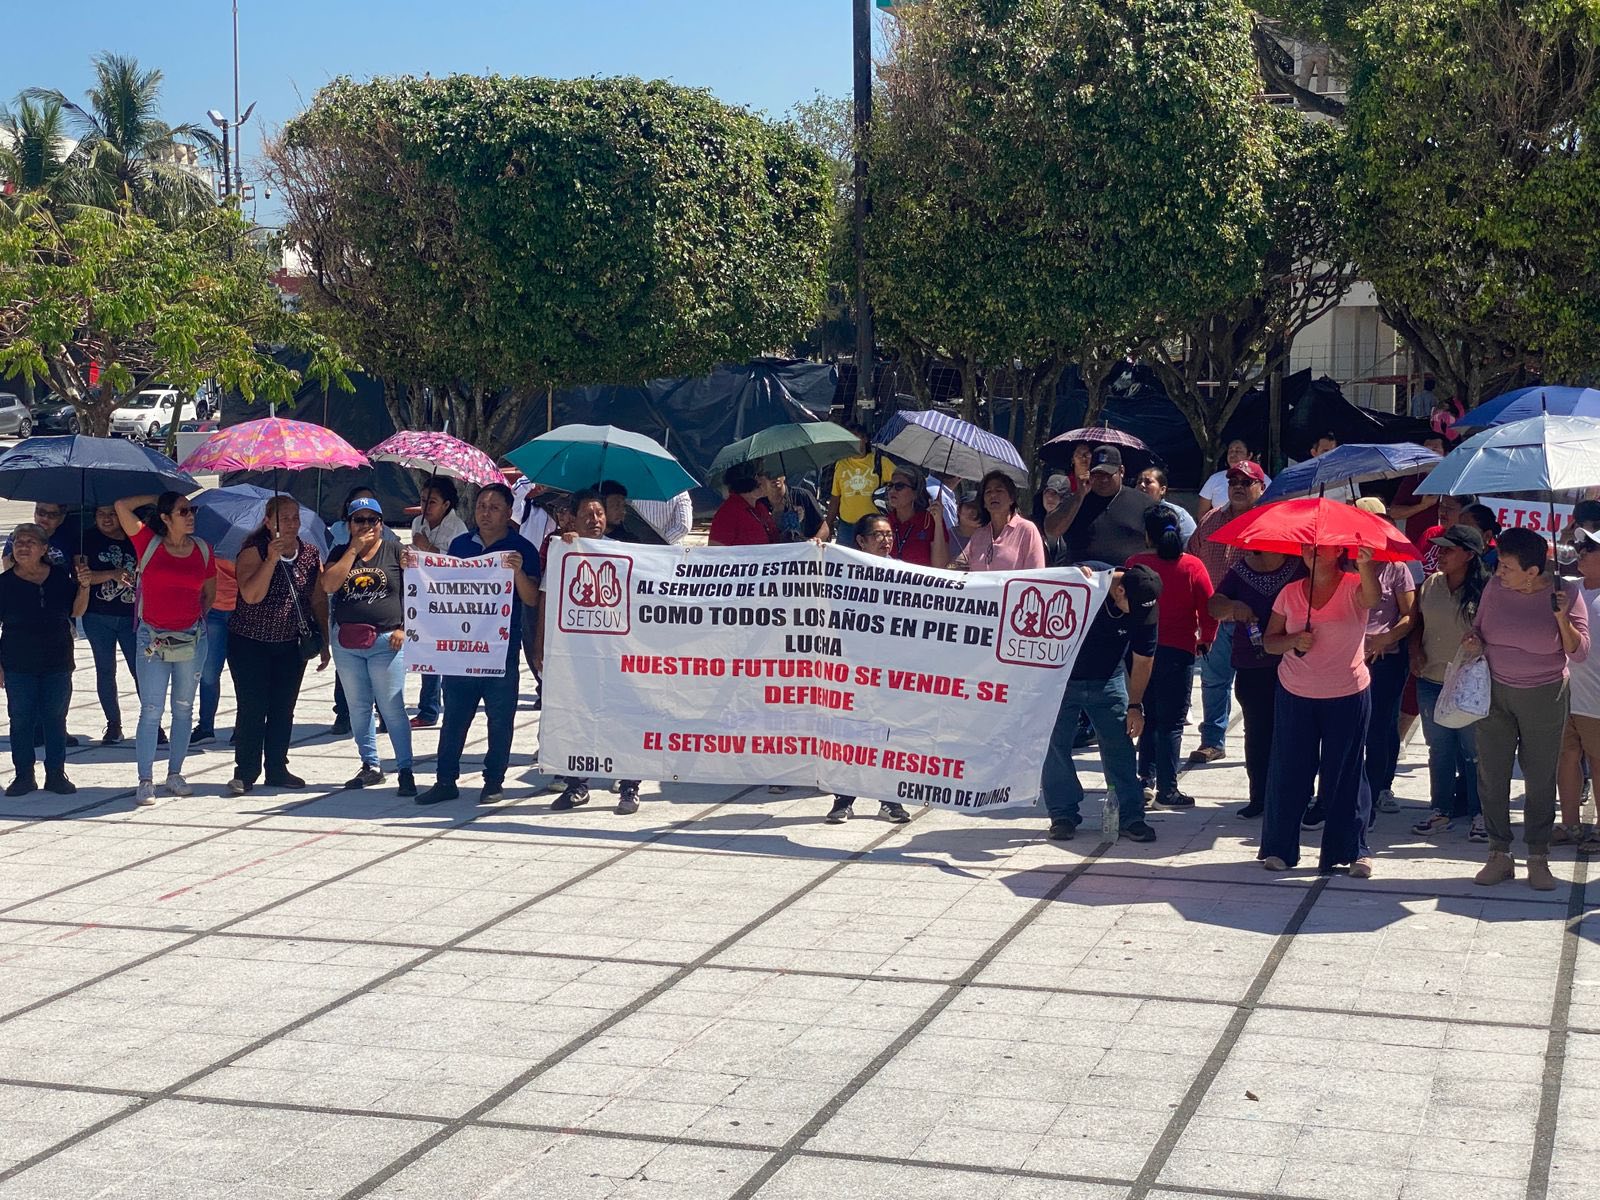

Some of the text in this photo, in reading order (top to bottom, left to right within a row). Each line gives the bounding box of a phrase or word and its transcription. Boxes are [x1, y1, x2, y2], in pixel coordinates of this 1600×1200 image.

[675, 560, 967, 591] SINDICATO ESTATAL DE TRABAJADORES
[427, 582, 501, 596] AUMENTO
[637, 580, 1000, 617] AL SERVICIO DE LA UNIVERSIDAD VERACRUZANA
[429, 601, 498, 616] SALARIAL
[566, 609, 622, 629] SETSUV
[638, 605, 994, 647] COMO TODOS LOS AÑOS EN PIE DE
[436, 640, 490, 653] HUELGA
[785, 635, 842, 657] LUCHA
[1006, 638, 1073, 662] SETSUV
[411, 664, 436, 672] F.C.A.
[620, 655, 1009, 703] NUESTRO FUTURO NO SE VENDE, SE
[764, 685, 855, 711] DEFIENDE
[567, 755, 613, 773] USBI-C
[643, 731, 663, 751] EL
[668, 733, 747, 754] SETSUV
[819, 740, 878, 768] PORQUE
[881, 749, 965, 780] RESISTE
[897, 781, 952, 805] CENTRO
[954, 788, 974, 806] DE
